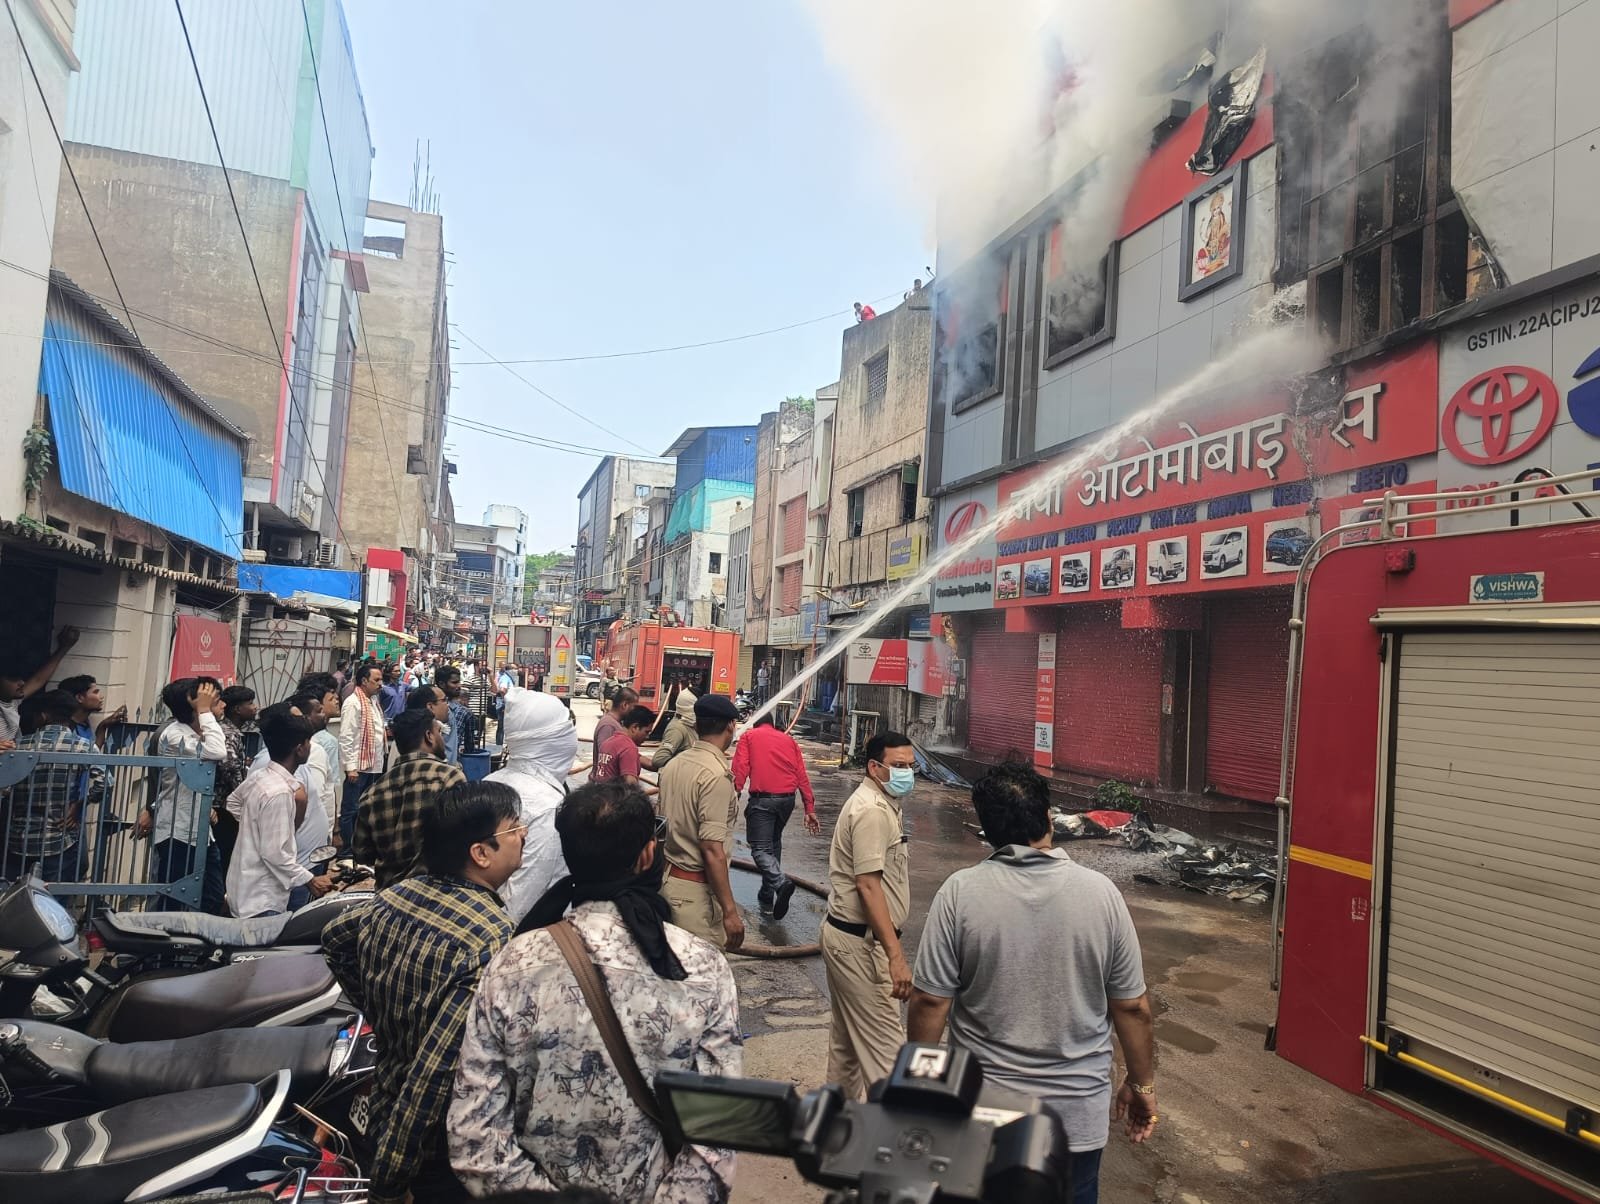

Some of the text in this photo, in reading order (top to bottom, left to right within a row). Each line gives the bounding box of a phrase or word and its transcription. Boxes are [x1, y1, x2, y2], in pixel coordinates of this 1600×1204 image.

[1351, 462, 1408, 493] JEETO
[1489, 580, 1537, 592] VISHWA
[719, 667, 728, 678] 2
